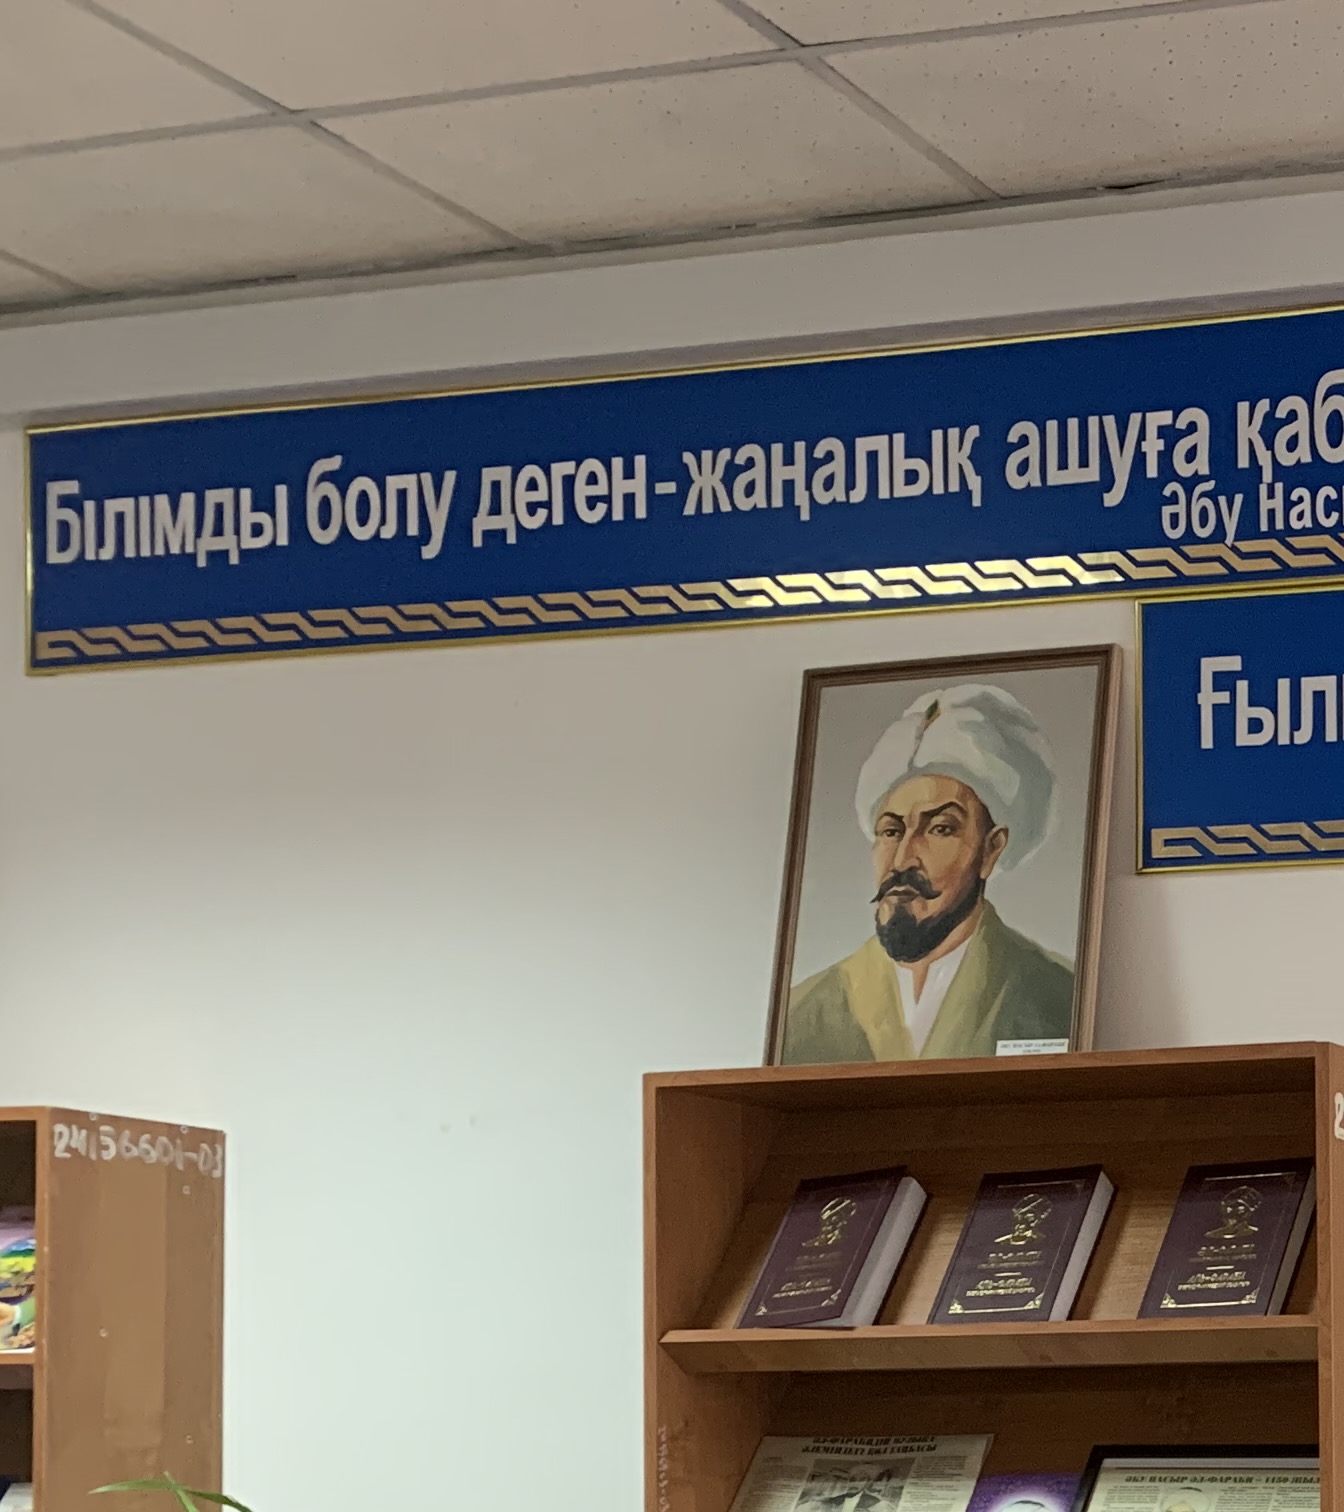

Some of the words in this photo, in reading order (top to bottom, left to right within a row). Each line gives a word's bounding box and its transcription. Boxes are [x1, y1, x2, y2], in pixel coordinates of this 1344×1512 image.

[307, 454, 456, 560] болу
[1005, 407, 1209, 507] ашуға
[1161, 478, 1243, 546] Әбу
